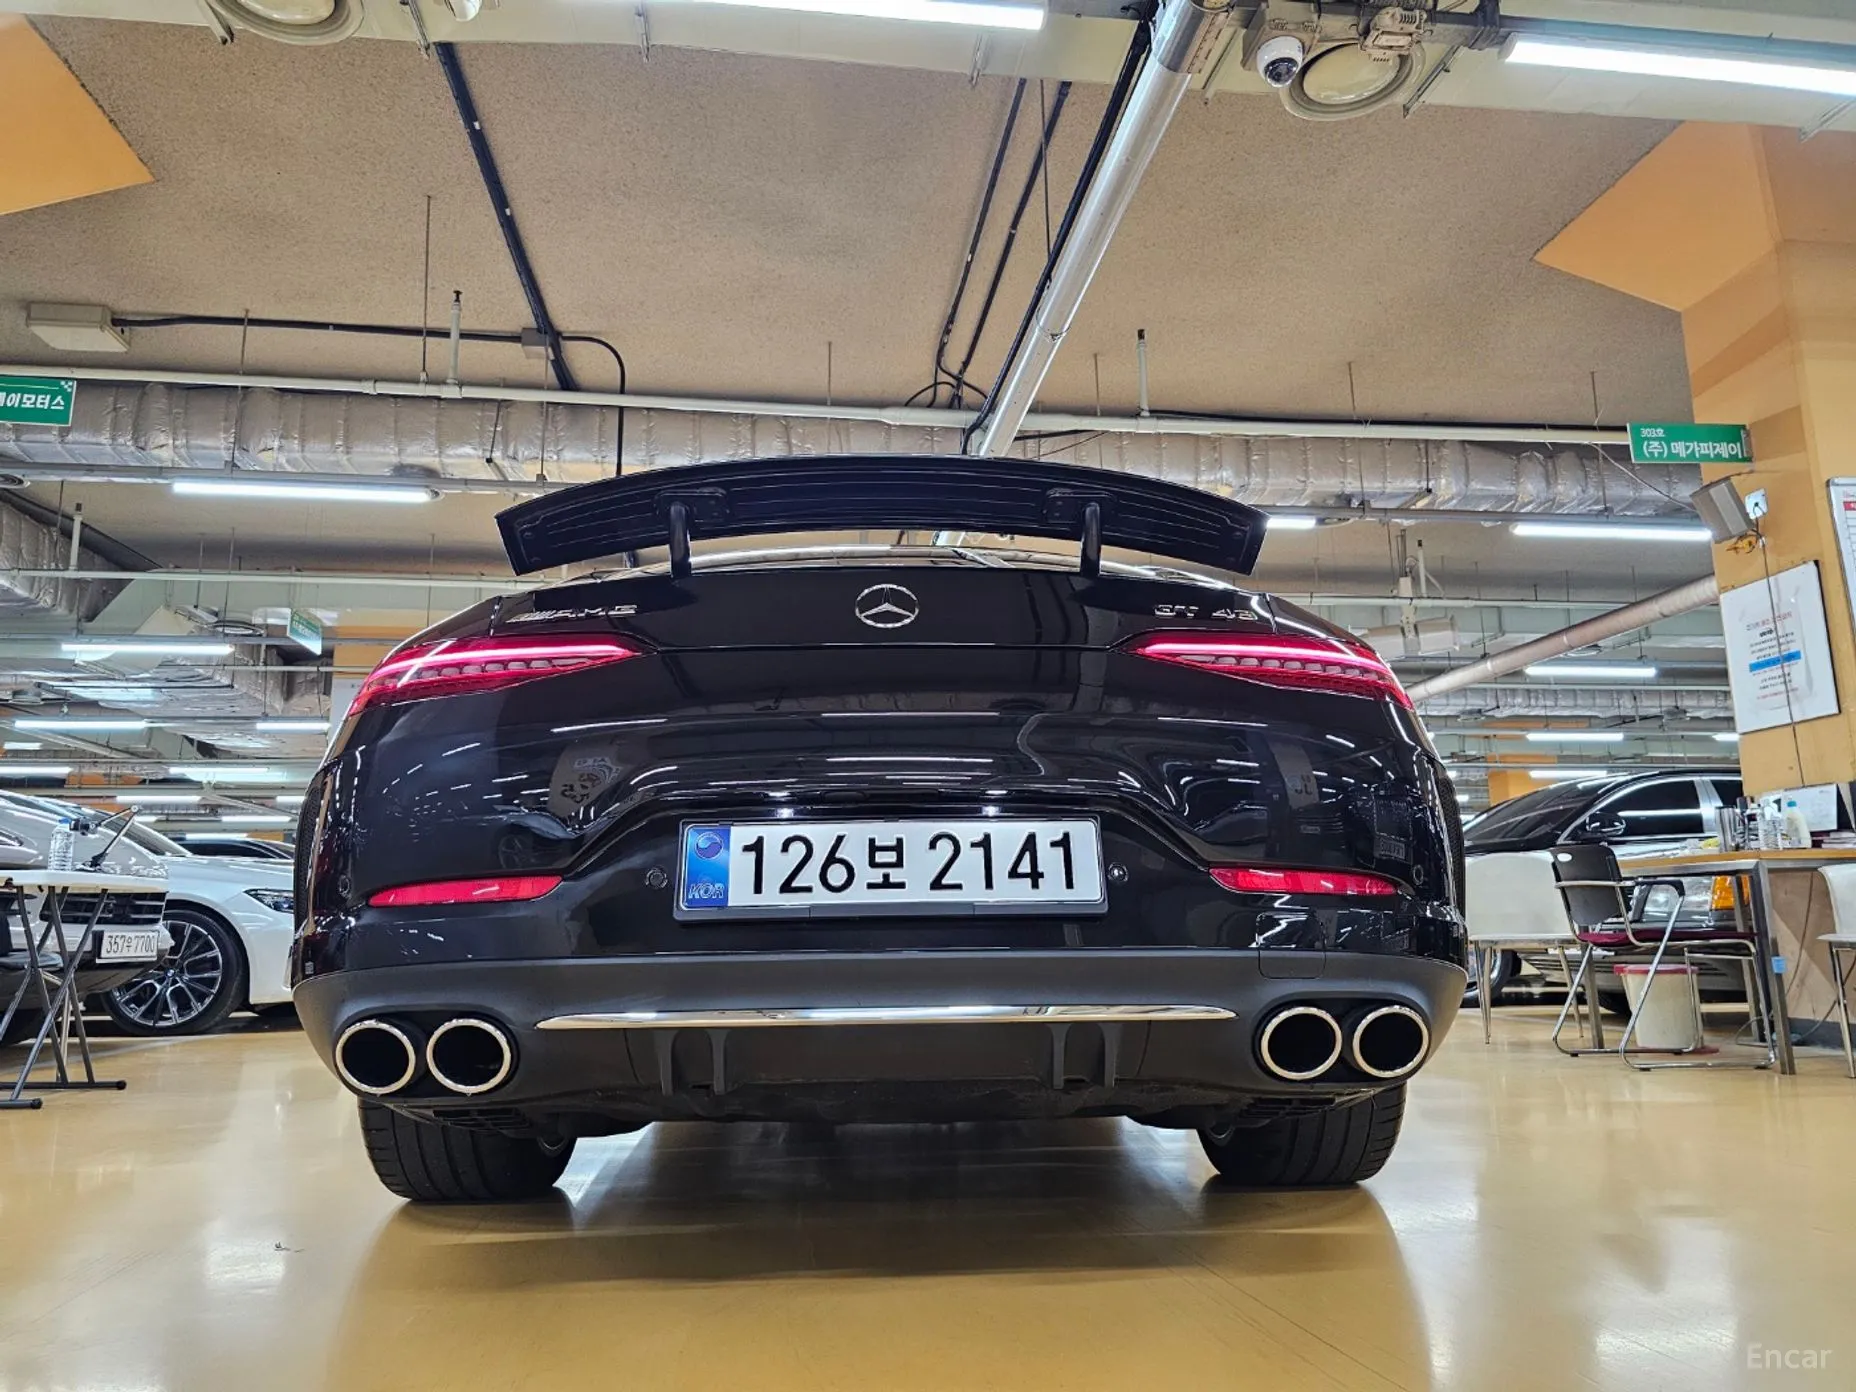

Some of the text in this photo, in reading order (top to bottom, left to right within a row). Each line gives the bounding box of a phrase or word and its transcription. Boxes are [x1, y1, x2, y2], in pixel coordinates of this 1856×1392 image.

[1643, 440, 1742, 459] (주) 메가피제이
[742, 831, 1076, 895] 126보 2141
[688, 882, 725, 899] KOR
